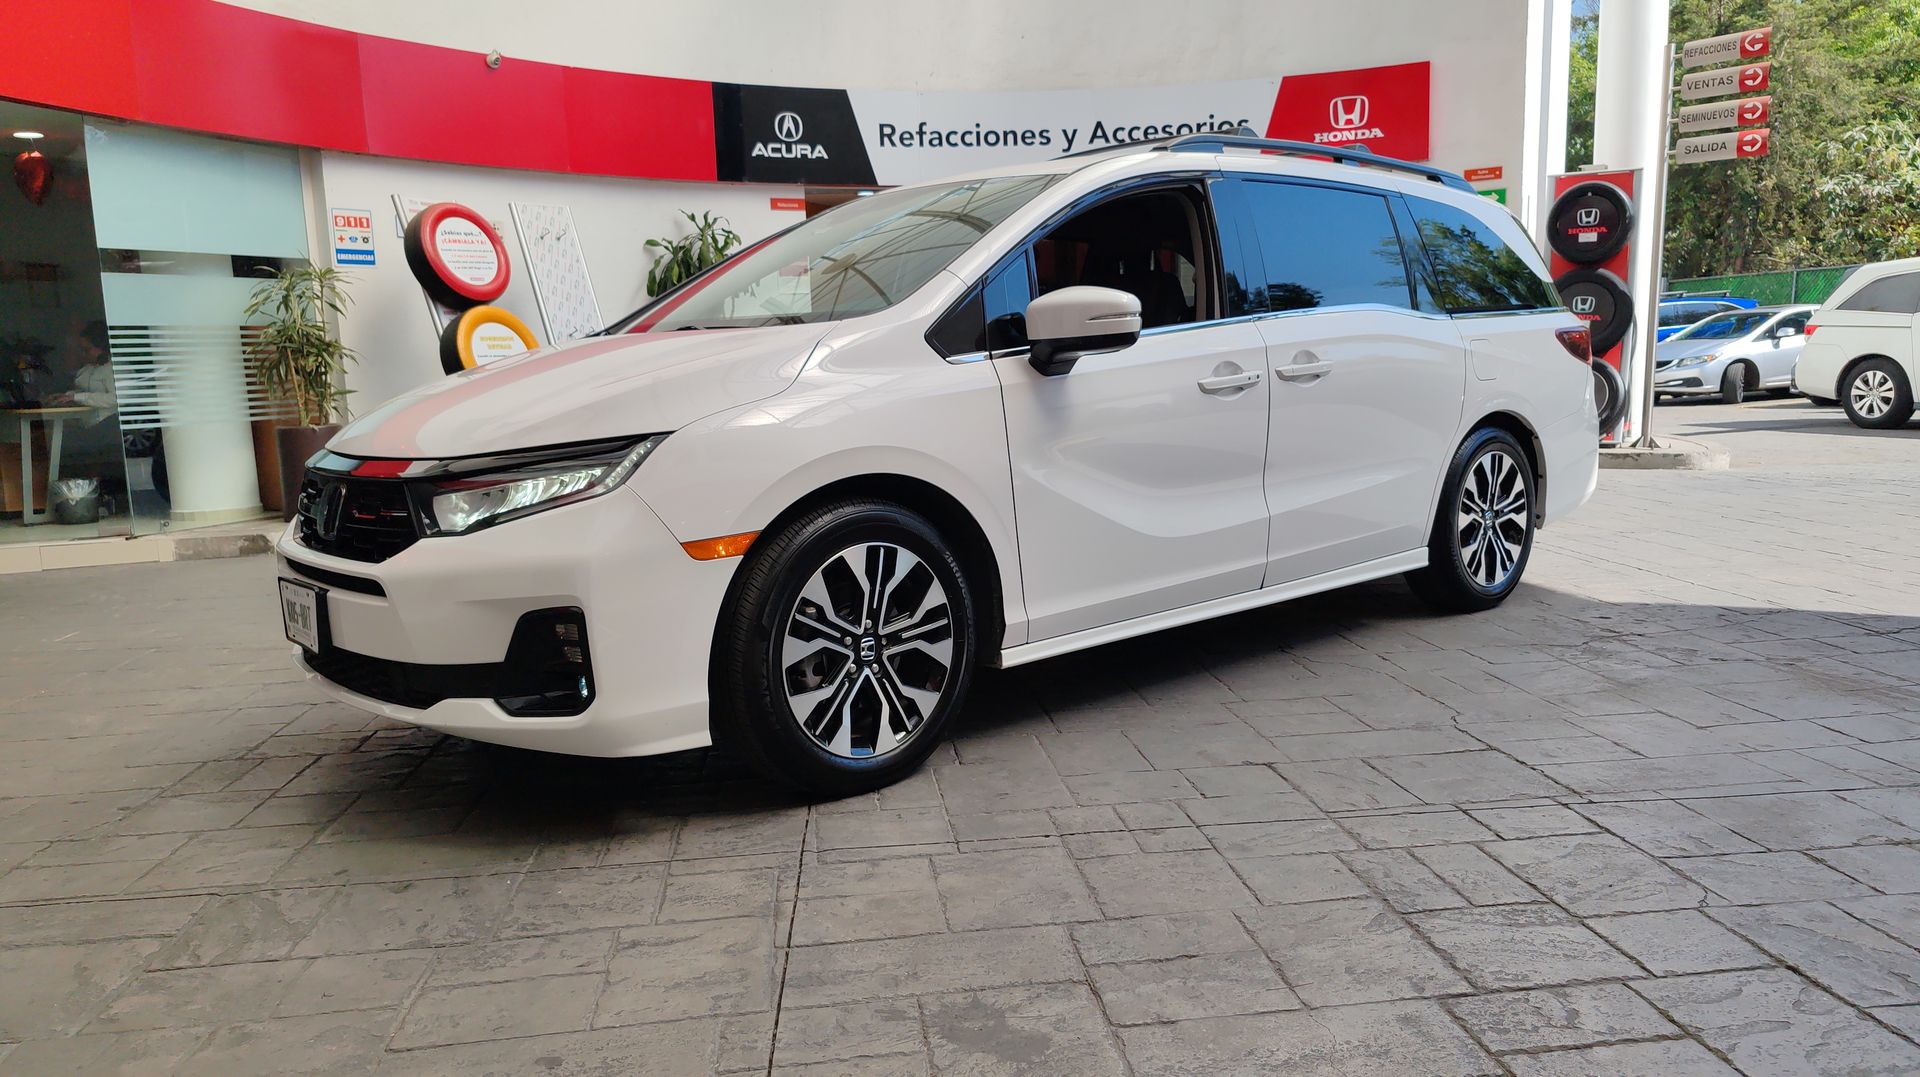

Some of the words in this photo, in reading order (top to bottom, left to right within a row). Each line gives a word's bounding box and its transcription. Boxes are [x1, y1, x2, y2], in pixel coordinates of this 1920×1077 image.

[1684, 41, 1737, 58] REFACCIONES
[1687, 75, 1734, 90] VENTAS
[1681, 108, 1735, 124] SEMINUEVOS
[878, 121, 1052, 148] Refacciones
[1061, 128, 1078, 152] y
[1313, 127, 1385, 143] HONDA
[751, 141, 829, 159] ACURA
[1684, 142, 1727, 155] SALIDA
[335, 216, 369, 228] 911
[1567, 226, 1608, 235] HONDA
